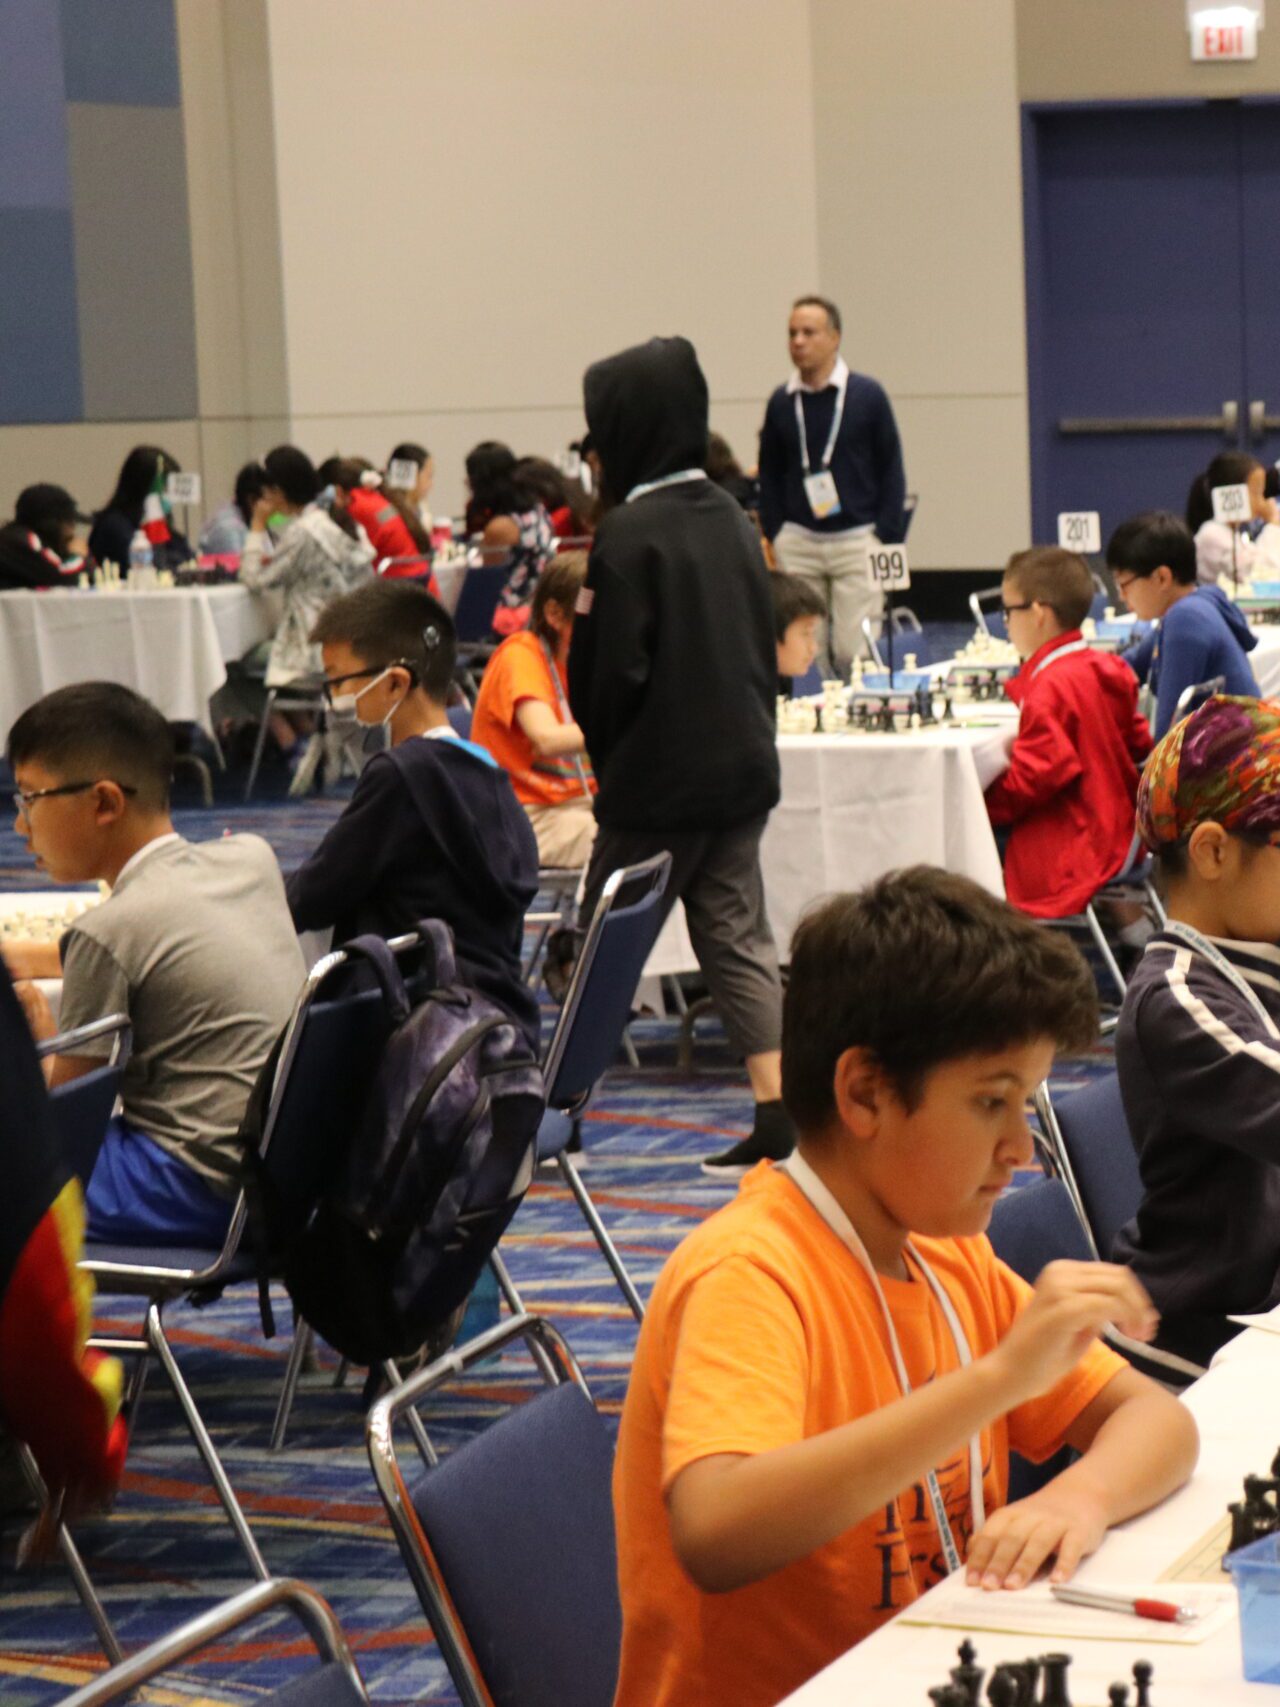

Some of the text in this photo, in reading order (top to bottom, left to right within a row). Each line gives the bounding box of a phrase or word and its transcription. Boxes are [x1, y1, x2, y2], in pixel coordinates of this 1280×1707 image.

[1203, 26, 1244, 56] EXIT
[1220, 489, 1244, 512] 203
[1065, 516, 1090, 540] 201
[869, 551, 904, 581] 199
